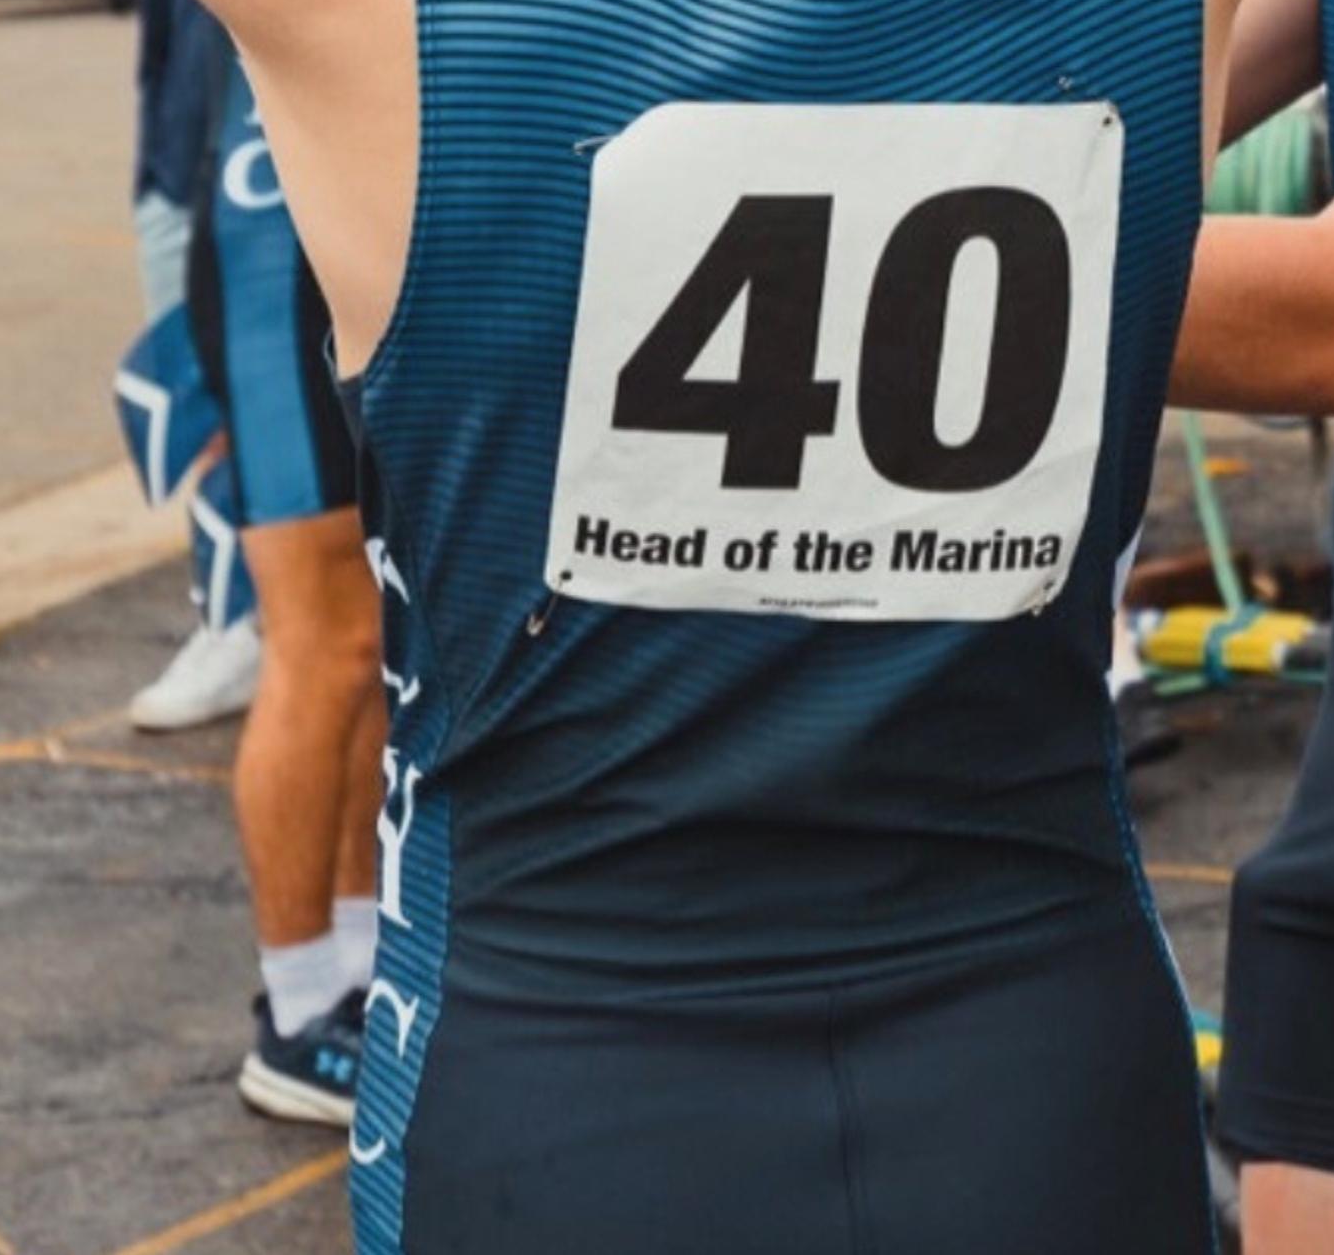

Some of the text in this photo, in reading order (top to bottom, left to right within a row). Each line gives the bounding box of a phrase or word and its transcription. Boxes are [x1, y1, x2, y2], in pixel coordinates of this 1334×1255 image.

[611, 186, 1072, 493] 40
[573, 515, 1062, 573] Head of the Marina
